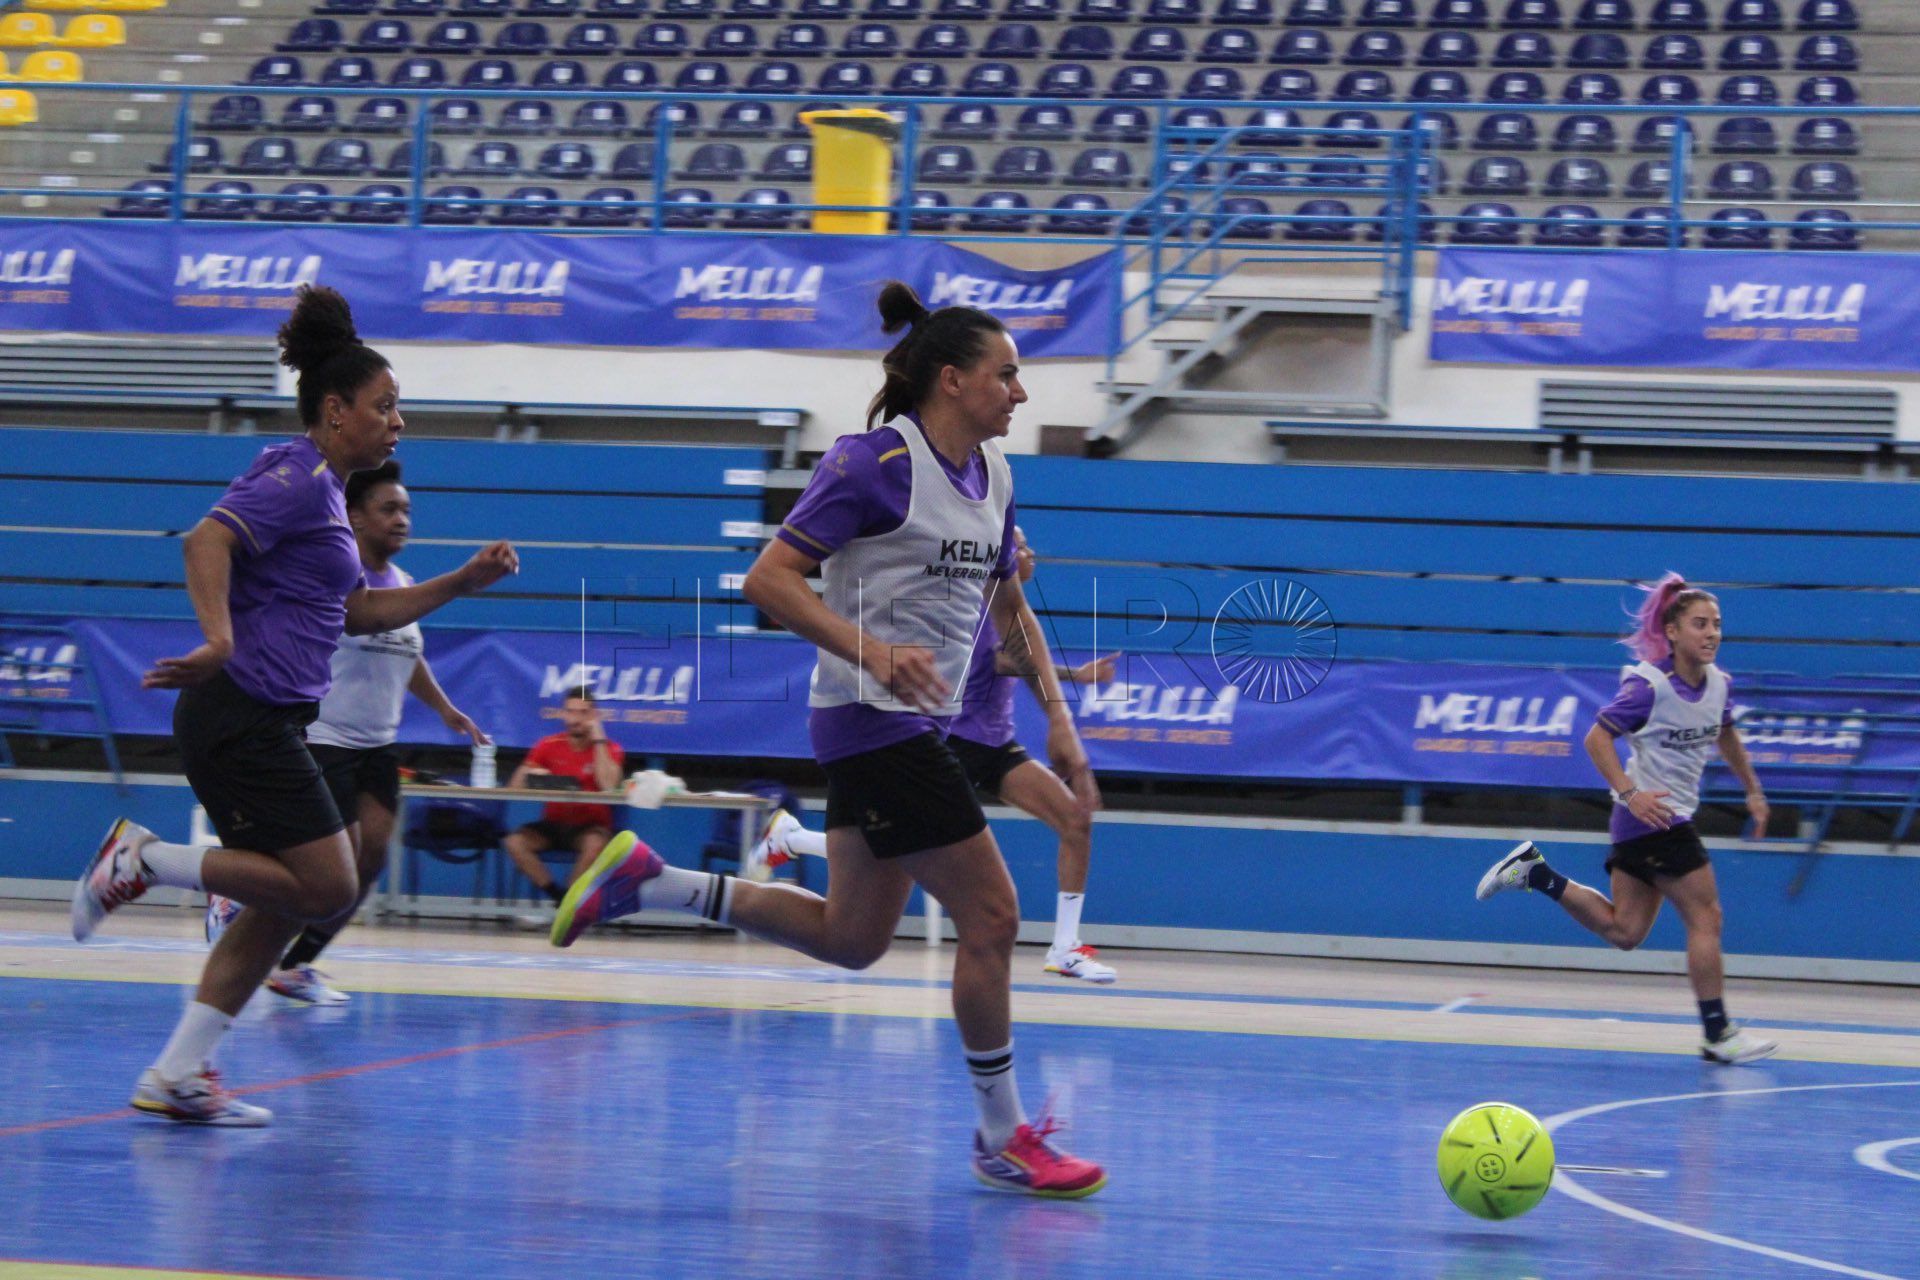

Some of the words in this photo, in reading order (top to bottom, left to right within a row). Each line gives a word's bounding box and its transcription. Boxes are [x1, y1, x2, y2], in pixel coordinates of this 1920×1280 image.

[174, 253, 322, 290] MELILLA
[422, 258, 570, 297] MELILLA
[674, 264, 824, 302] MELILLA
[928, 271, 1074, 310] MELILLA
[1431, 276, 1589, 317] MELILLA
[1703, 282, 1867, 322] MELILLA
[940, 539, 1000, 565] KELM
[1078, 682, 1240, 725] MELILLA
[1414, 692, 1579, 736] MELILLA
